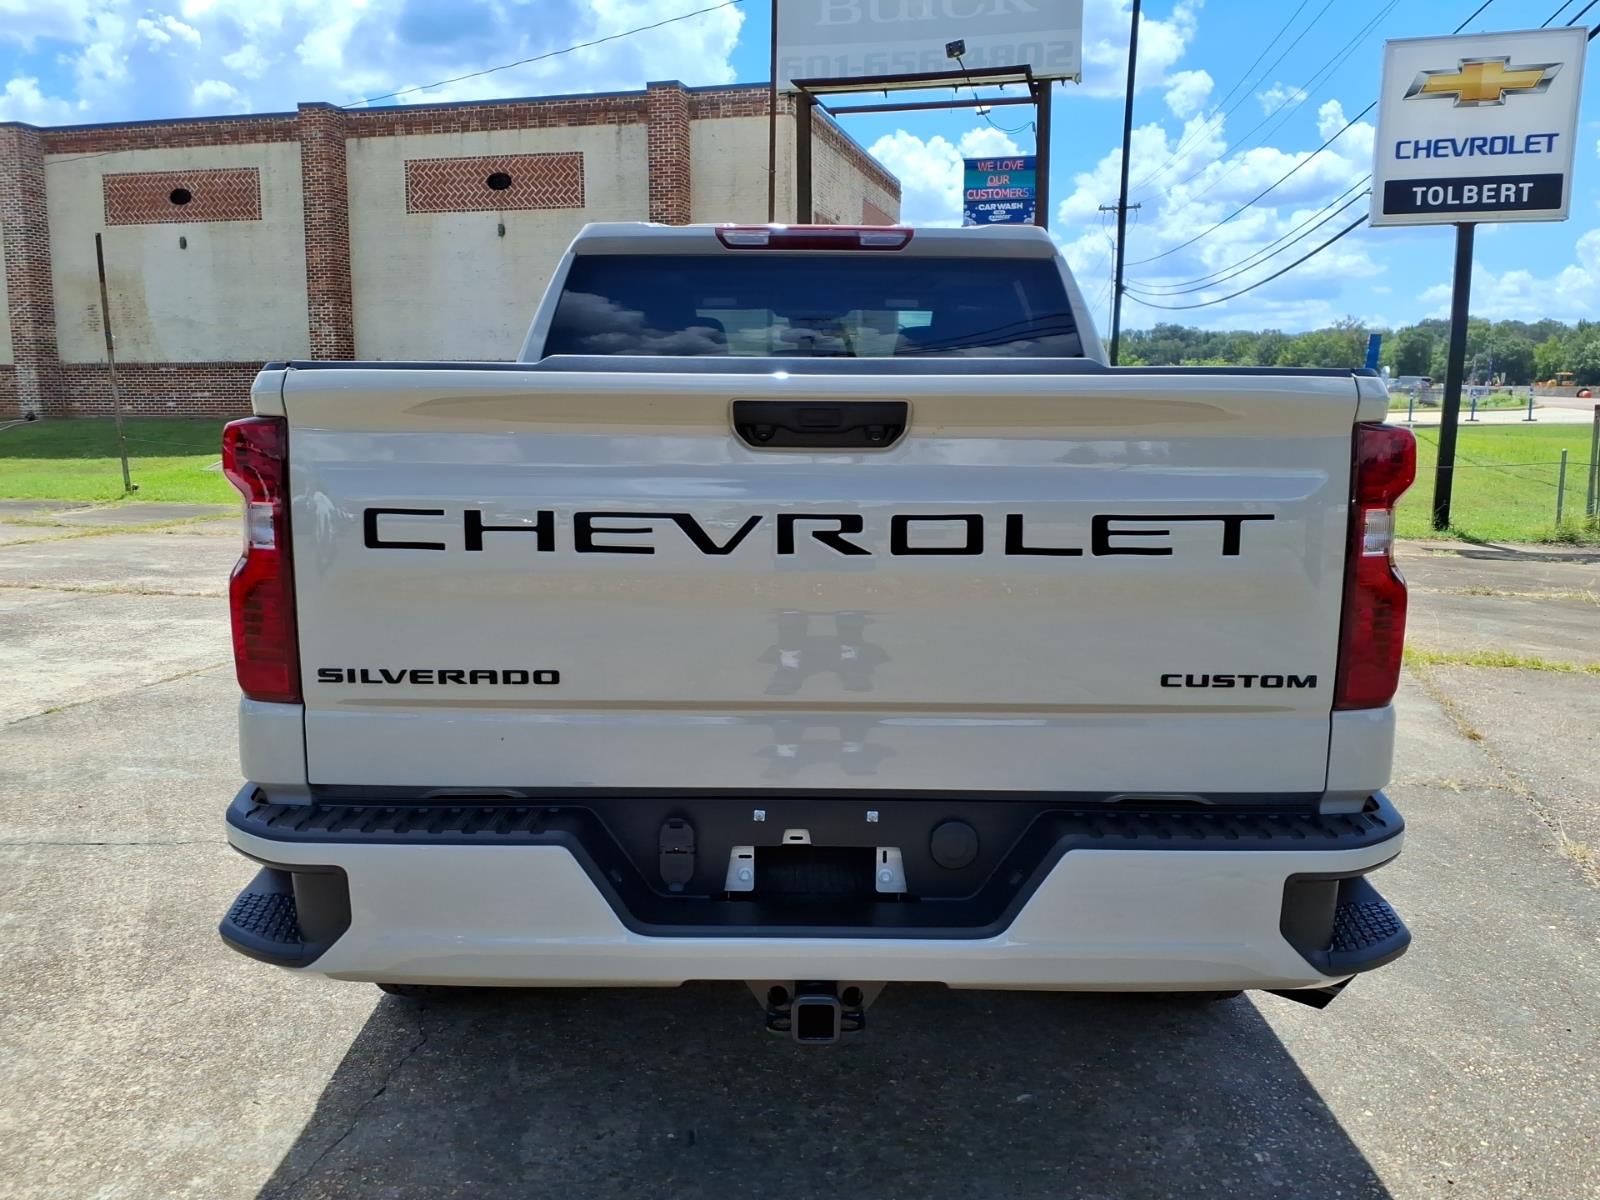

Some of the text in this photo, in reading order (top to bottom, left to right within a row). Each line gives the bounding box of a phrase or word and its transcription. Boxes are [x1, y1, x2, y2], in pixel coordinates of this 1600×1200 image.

[1395, 133, 1560, 160] CHEVROLET
[977, 160, 1024, 172] WE LOVE
[987, 175, 1010, 186] OUR
[1412, 182, 1535, 206] TOLBERT
[997, 202, 1023, 210] WASH
[364, 507, 1275, 557] CHEVROLET
[317, 667, 561, 685] SILVERADO
[1160, 674, 1318, 689] CUSTOM
